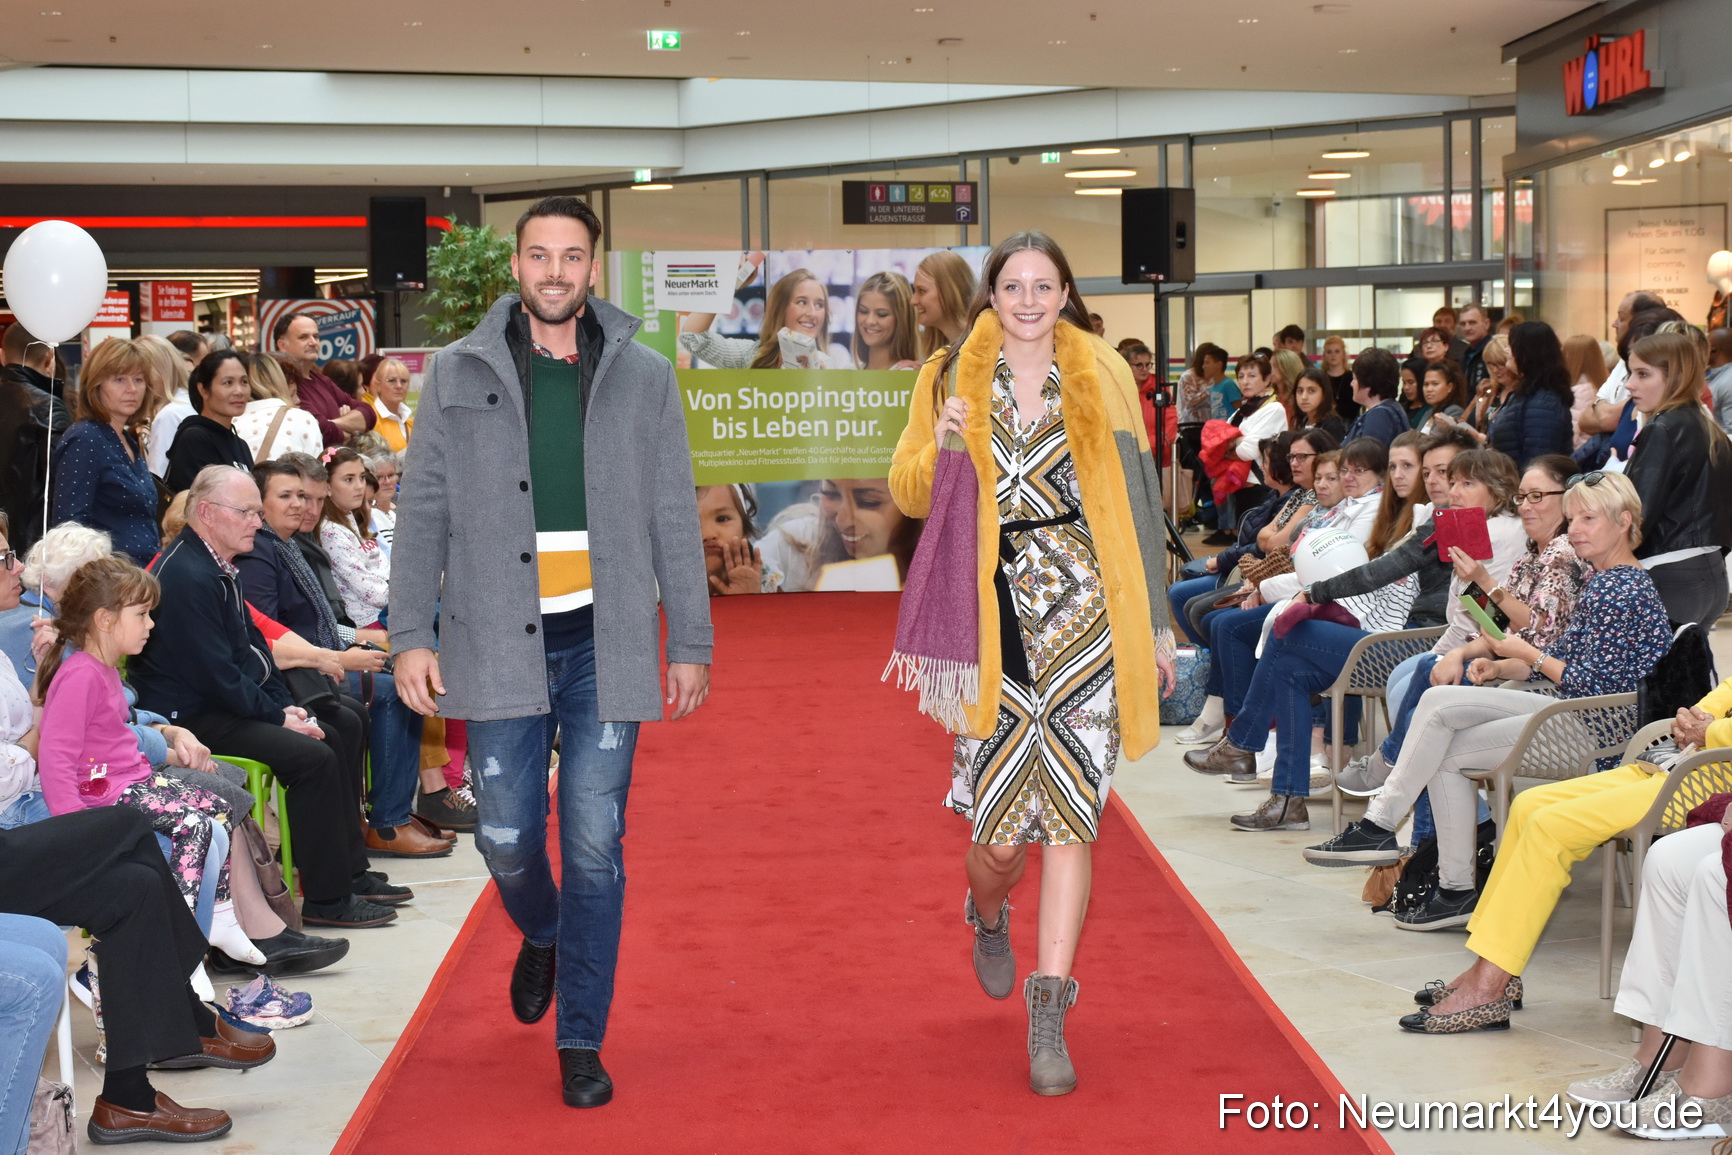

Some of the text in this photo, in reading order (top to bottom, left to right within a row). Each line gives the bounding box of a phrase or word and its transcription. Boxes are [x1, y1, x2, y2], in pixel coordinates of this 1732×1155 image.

[1563, 29, 1650, 117] WÖHRL
[664, 280, 719, 289] NeuerMarkt
[316, 310, 357, 325] VERKAUF
[319, 334, 356, 360] 0%
[686, 386, 910, 414] Von Shoppingtour
[712, 416, 882, 442] bis Leben pur.
[691, 450, 735, 458] Stadtquartier
[784, 447, 807, 455] treffen
[820, 446, 856, 454] Geschäfte
[857, 446, 869, 454] auf
[698, 458, 743, 468] Multiplexkino
[758, 456, 806, 464] Fitnessstudio.
[841, 456, 860, 464] jeden
